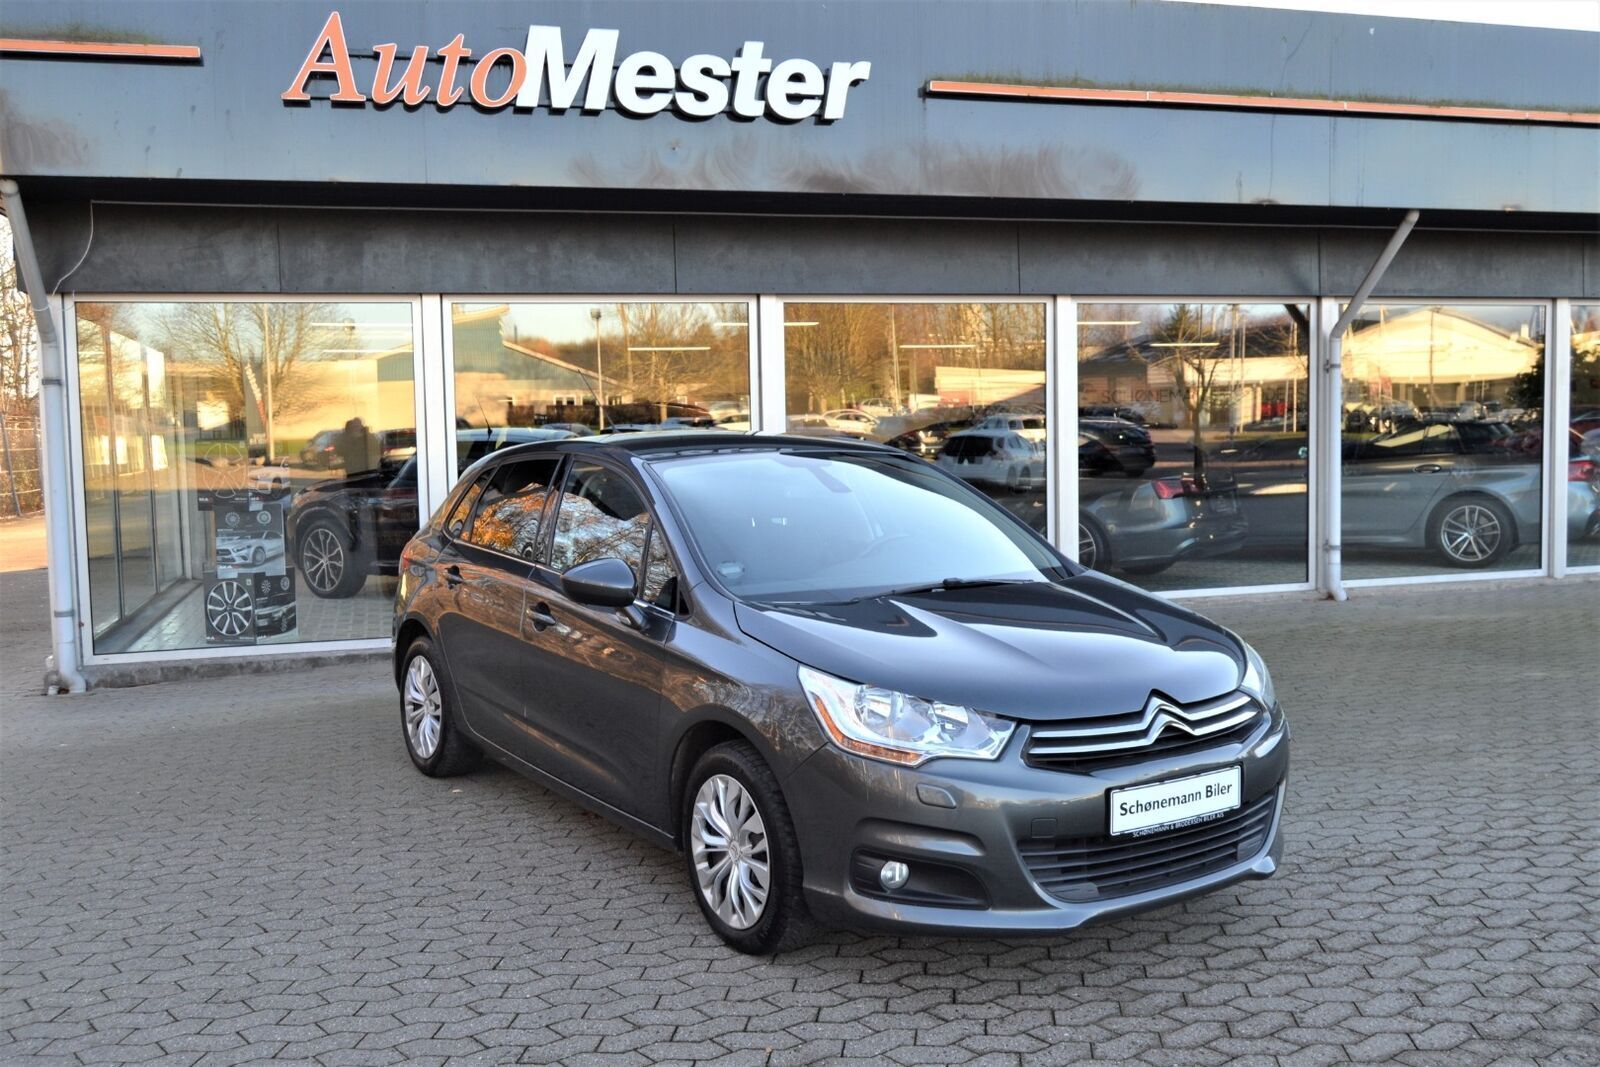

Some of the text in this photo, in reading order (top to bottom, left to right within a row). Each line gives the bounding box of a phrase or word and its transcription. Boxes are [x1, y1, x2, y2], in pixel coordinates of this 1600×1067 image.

[280, 10, 872, 121] AutoMester
[1119, 783, 1233, 817] Schønemann Biler
